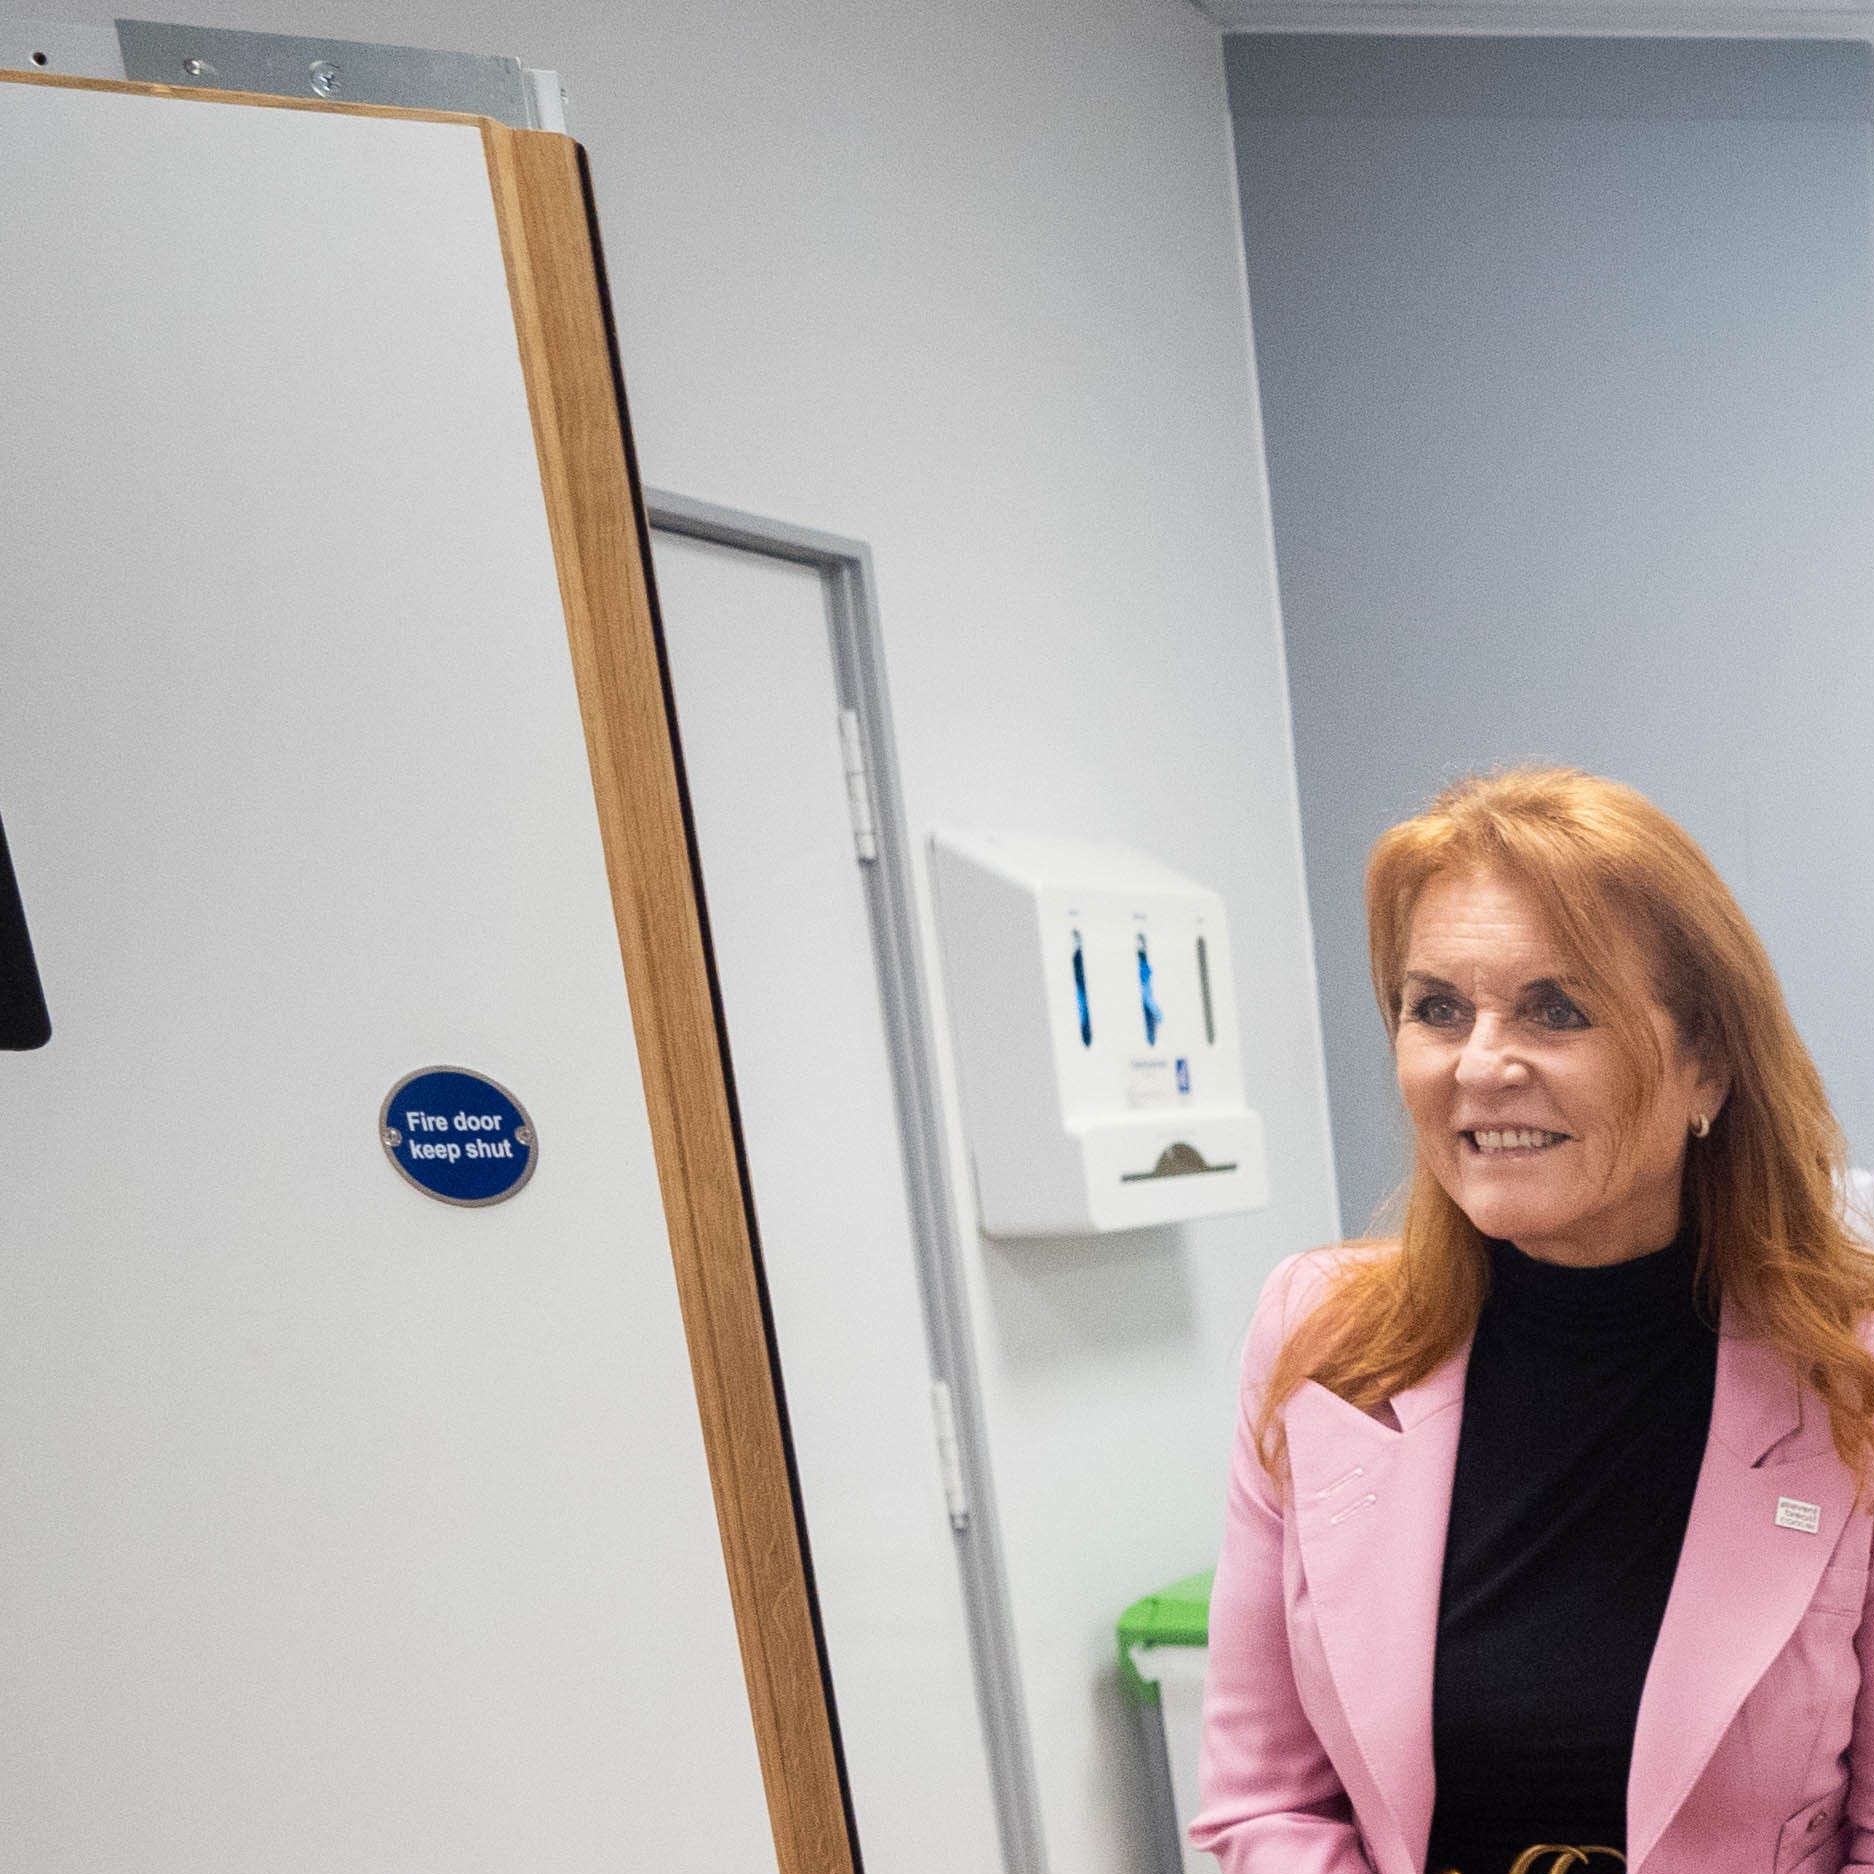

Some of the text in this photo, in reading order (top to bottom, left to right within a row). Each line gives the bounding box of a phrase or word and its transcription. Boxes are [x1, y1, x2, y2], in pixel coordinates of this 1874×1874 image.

[406, 1110, 502, 1132] Fire door
[409, 1138, 514, 1164] keep shut
